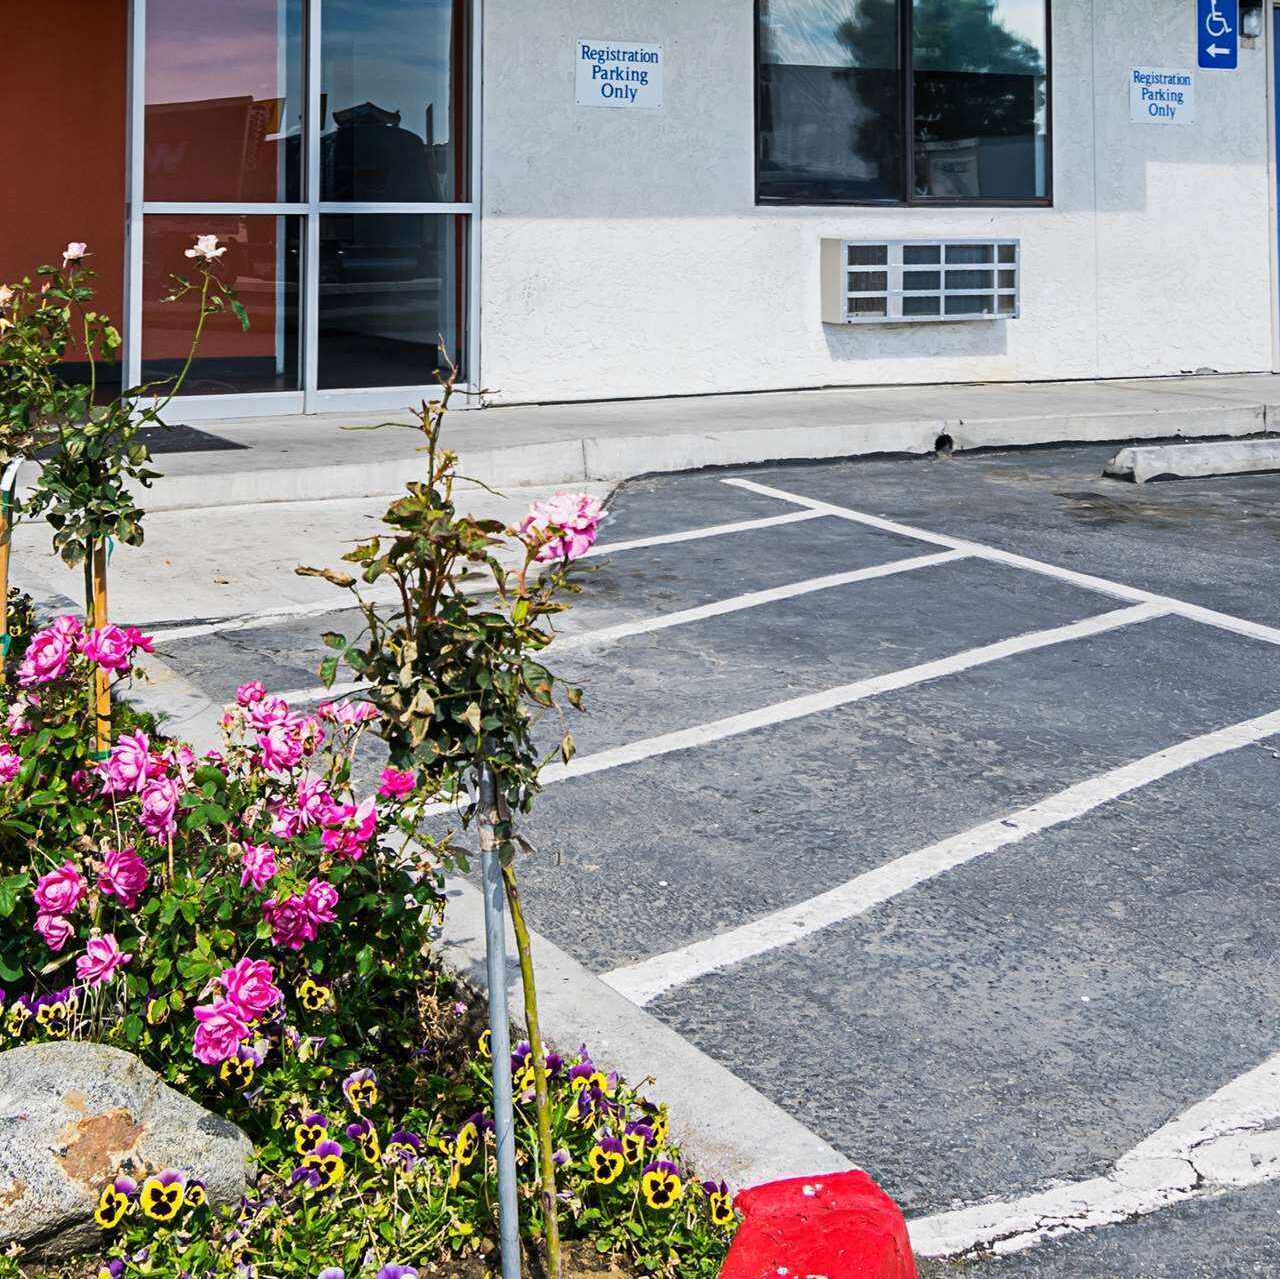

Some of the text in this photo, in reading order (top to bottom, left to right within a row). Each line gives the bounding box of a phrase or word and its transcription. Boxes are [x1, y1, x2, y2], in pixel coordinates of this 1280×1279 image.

[581, 44, 659, 64] Registration
[592, 64, 648, 86] Parking
[1133, 70, 1191, 87] Registration
[601, 82, 638, 103] Only
[1142, 87, 1184, 105] Parking
[1149, 103, 1176, 120] Only
